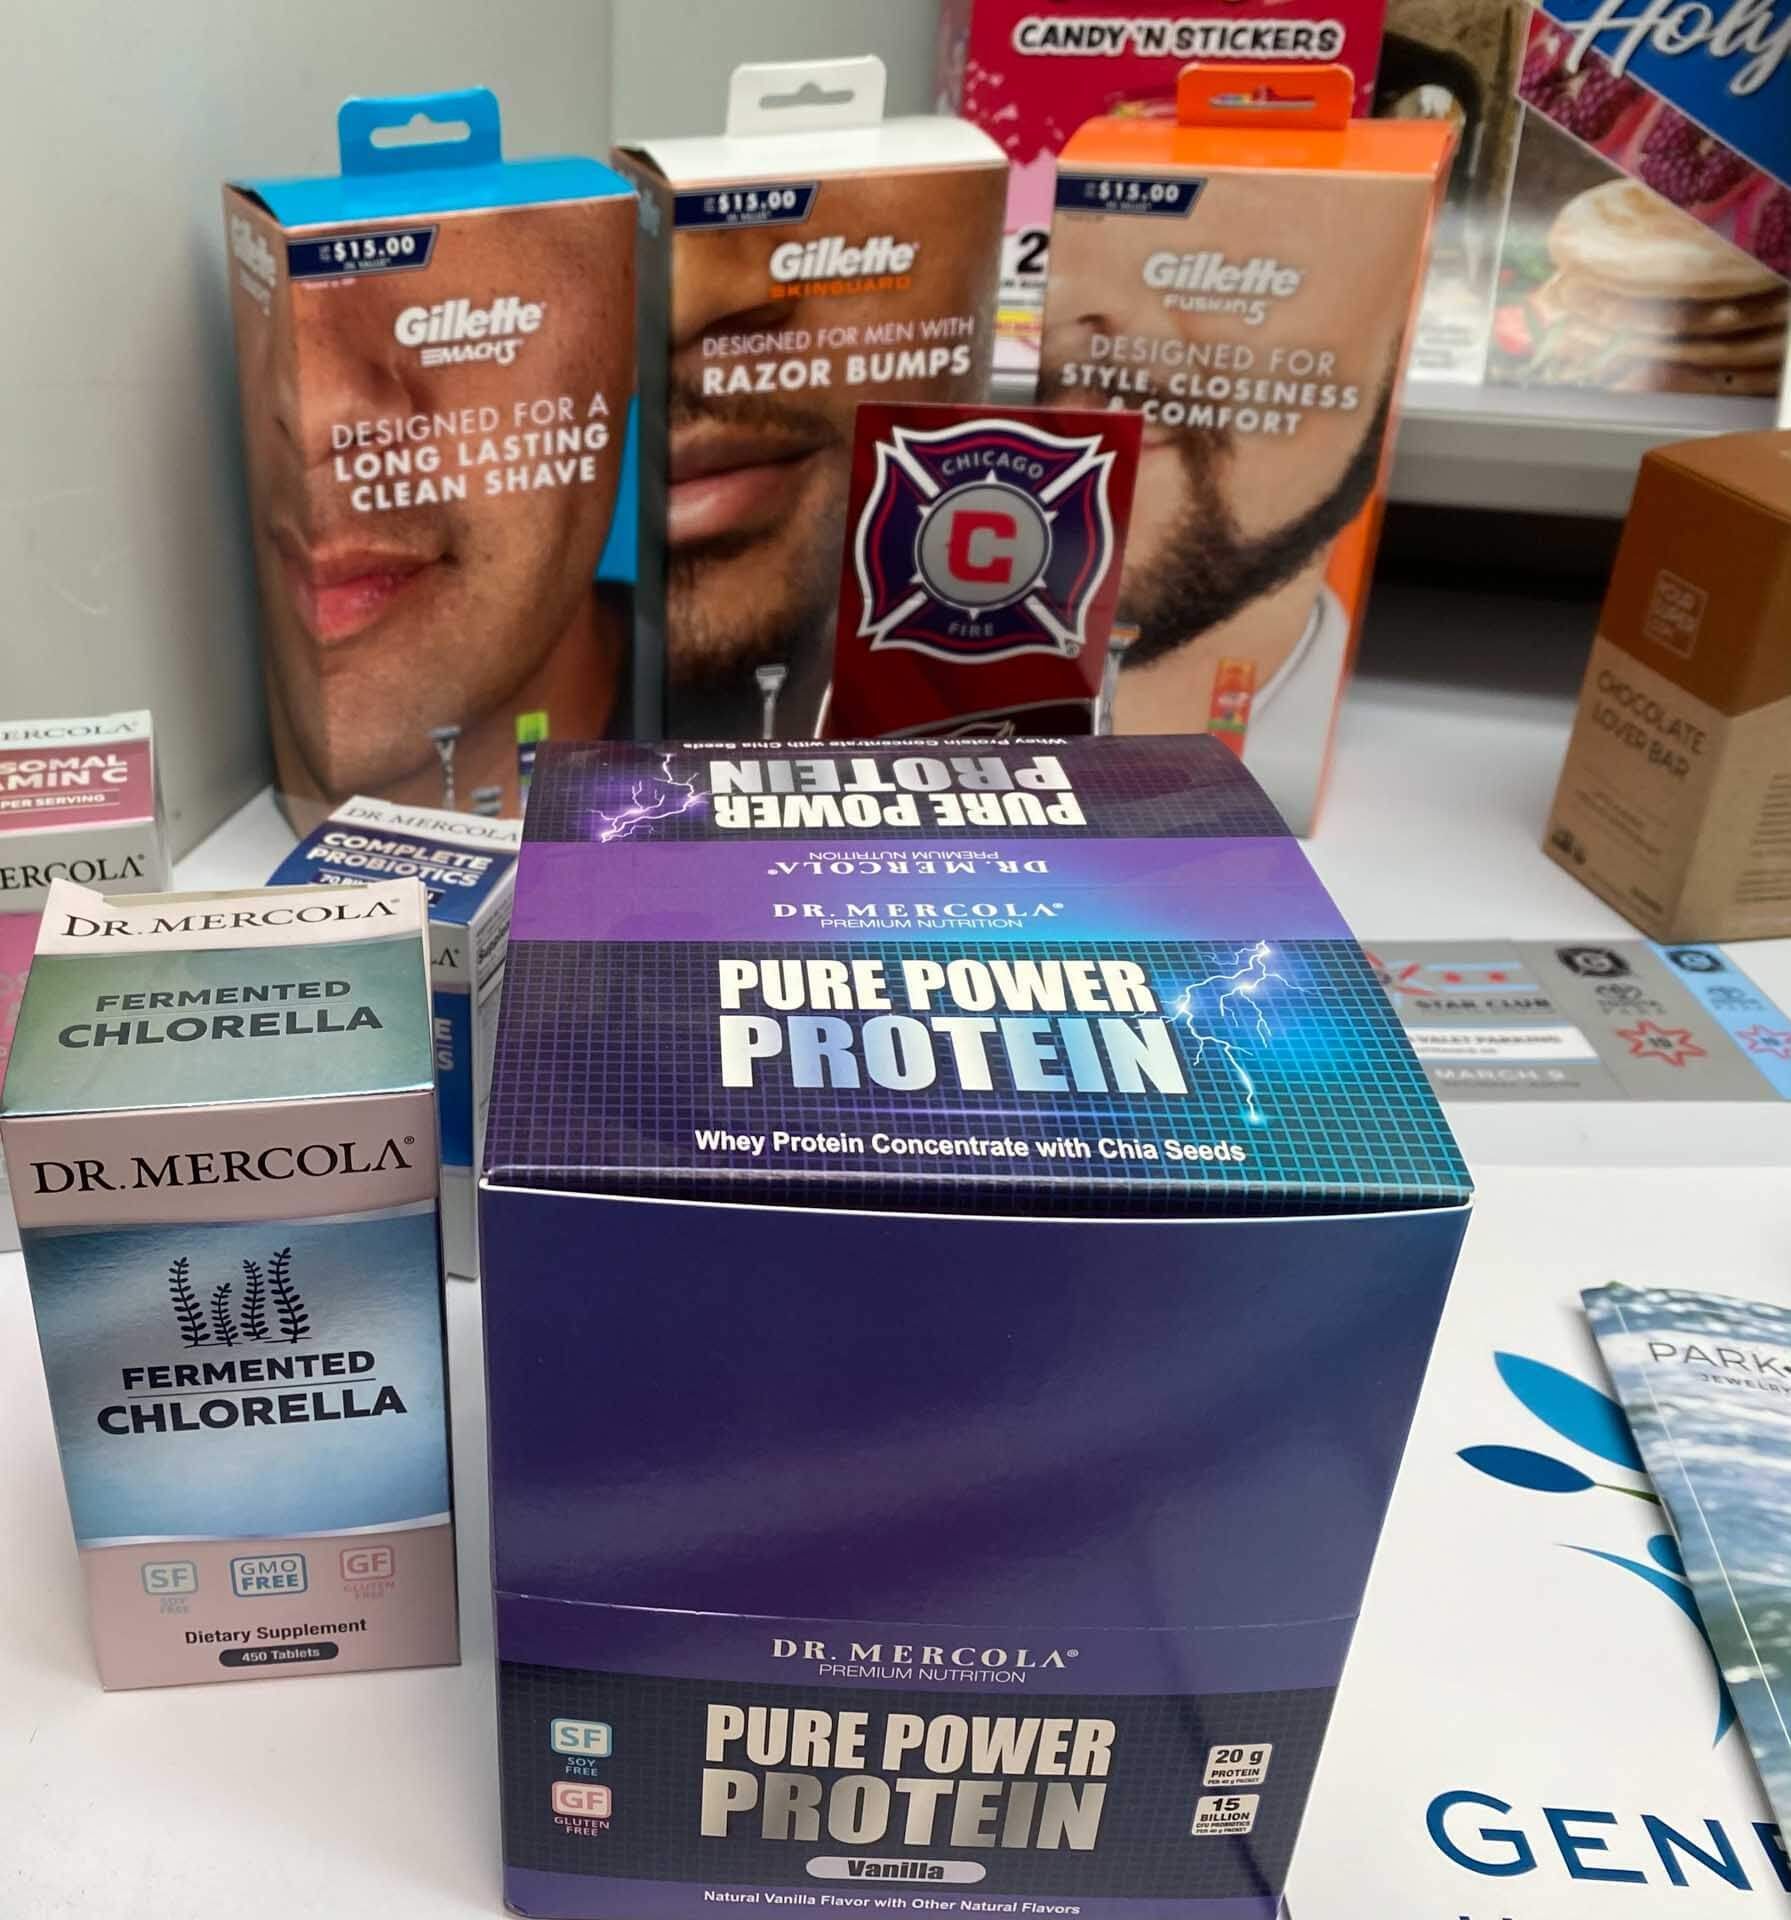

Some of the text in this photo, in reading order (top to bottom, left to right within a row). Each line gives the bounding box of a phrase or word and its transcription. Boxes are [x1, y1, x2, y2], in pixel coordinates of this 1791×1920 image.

[1018, 22, 1126, 49] CANDY
[1174, 24, 1341, 53] STICKERS
[717, 190, 797, 214] $15.00
[1099, 182, 1180, 202] $15.00
[333, 234, 416, 262] $15.00
[769, 235, 916, 282] Gillette
[1143, 250, 1301, 297] Gillette
[394, 296, 544, 347] Gillette
[702, 315, 976, 358] DESIGNED FOR MEN WITH
[1090, 333, 1336, 377] DESIGNED FOR
[702, 344, 971, 395] RAZOR BUMPS
[1168, 372, 1361, 411] CLOSENESS
[331, 391, 610, 449] DESIGNED FOR A
[1143, 398, 1301, 435] COMFORT
[334, 422, 610, 483] LONG LASTING
[941, 450, 1045, 479] CHICAGO
[351, 456, 597, 512] CLEAN SHAVE
[946, 510, 1018, 585] C
[947, 622, 995, 639] FIRE
[102, 767, 129, 784] C
[710, 755, 1073, 794] PROTEIN
[36, 793, 106, 807] SERVING
[713, 791, 1087, 829] PURE POWER
[321, 832, 493, 872] COMPLETE
[809, 851, 999, 861] PREMIUM NUTRITION
[305, 846, 482, 888] PROBIOTICS
[772, 902, 836, 919] DR.
[820, 918, 1024, 929] PREMIUM NUTRITION
[60, 913, 143, 939] DR.
[94, 979, 352, 1014] FERMENTED
[717, 958, 1161, 1013] PURE POWER
[56, 1005, 385, 1050] CHLORELLA
[719, 1014, 1189, 1095] PROTEIN
[694, 1128, 1247, 1163] Whey Protein Concentrate with Chia Seeds
[30, 1159, 127, 1195] DR.
[121, 1349, 377, 1392] FERMENTED
[1647, 1341, 1788, 1378] PARK
[96, 1384, 409, 1437] CHLORELLA
[240, 1558, 298, 1576] GMO
[346, 1551, 390, 1576] GF
[150, 1567, 190, 1589] SF
[241, 1574, 300, 1592] FREE
[184, 1617, 368, 1645] Dietary Supplement
[240, 1647, 321, 1663] 450 Tablets
[771, 1637, 837, 1662] DR.
[818, 1663, 1026, 1684] PREMIUM NUTRITION
[560, 1726, 602, 1749] SF
[704, 1702, 1117, 1777] PURE POWER
[566, 1757, 596, 1768] SOY
[1214, 1748, 1265, 1766] 20 g
[565, 1766, 599, 1777] FREE
[1210, 1767, 1260, 1778] PROTEIN
[559, 1789, 604, 1810] GF
[700, 1767, 1108, 1851] PROTEIN
[1212, 1797, 1241, 1812] 15
[553, 1816, 611, 1830] GLUTEN
[1199, 1811, 1251, 1822] BILLION
[565, 1826, 600, 1837] FREE
[846, 1859, 945, 1881] Vanilla
[703, 1889, 1081, 1916] Natural Vanilla Flavor with Other Natural Flavors
